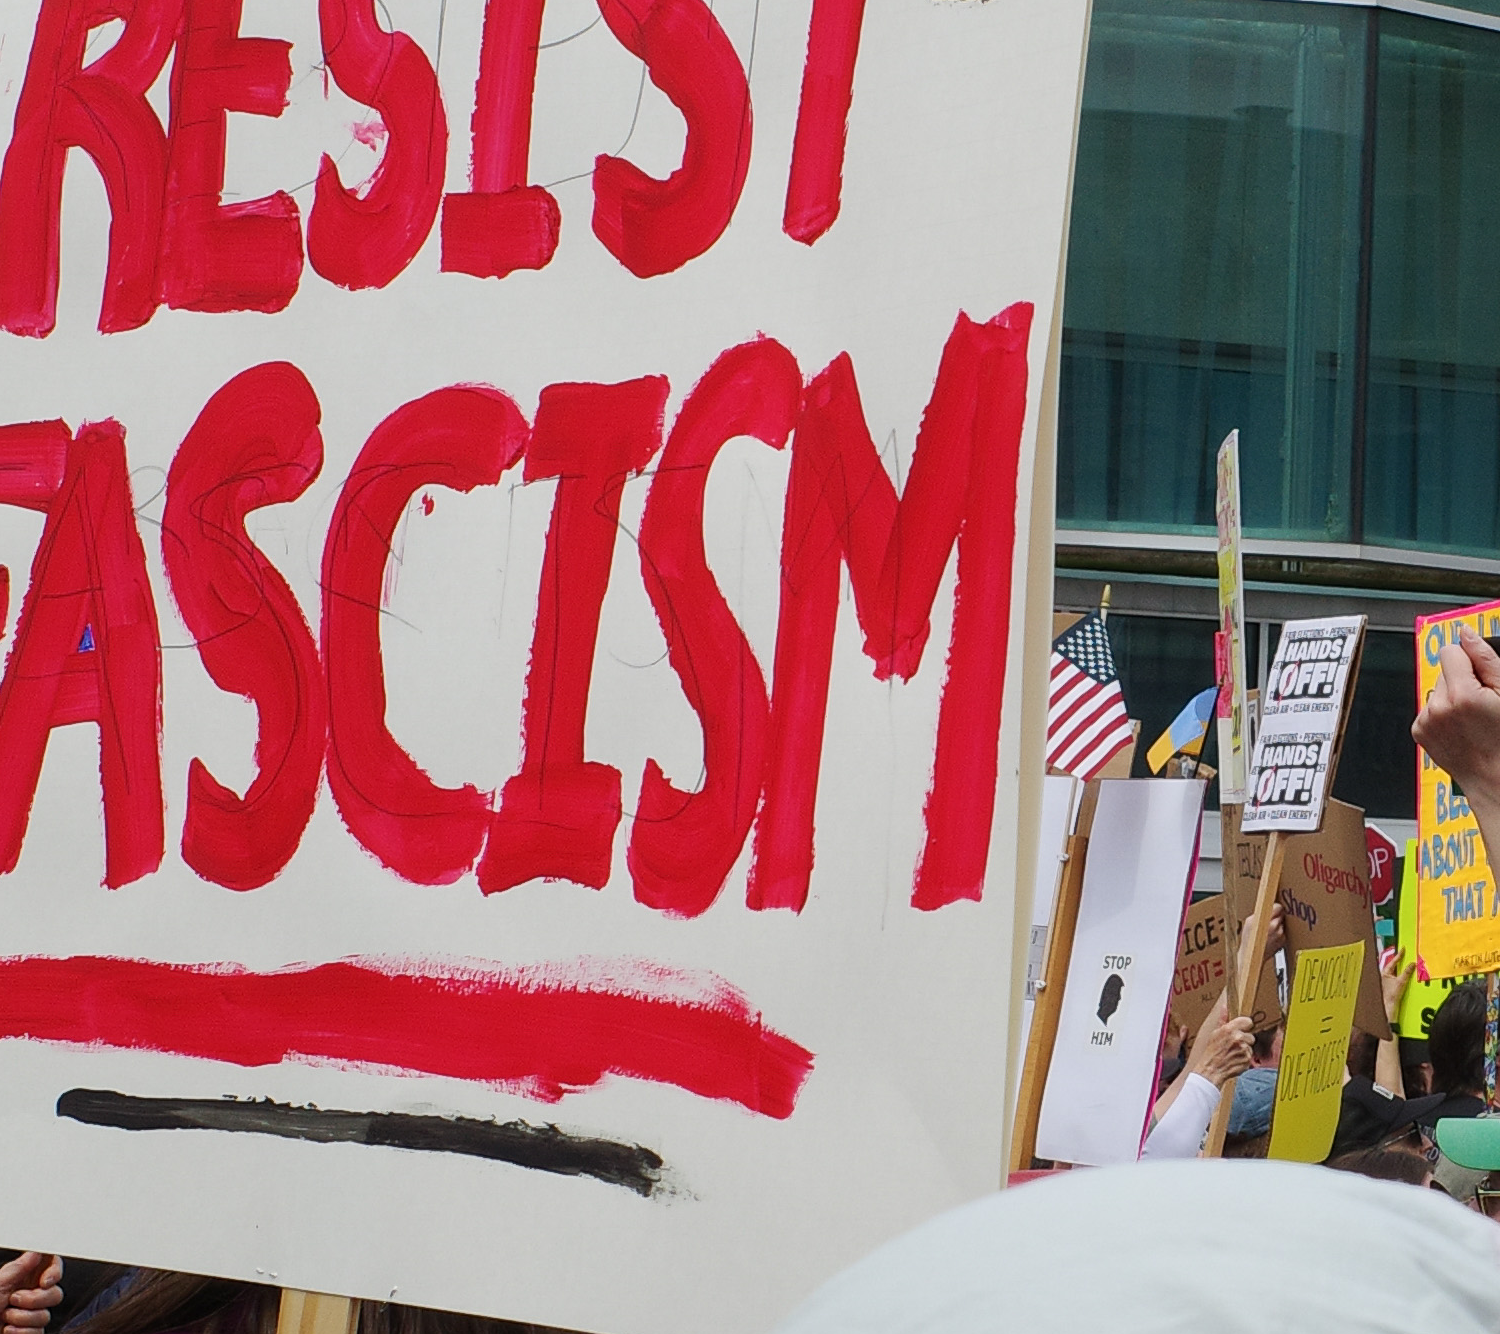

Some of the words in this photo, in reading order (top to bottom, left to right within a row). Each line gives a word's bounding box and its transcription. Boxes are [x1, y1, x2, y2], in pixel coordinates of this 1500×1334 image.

[1284, 638, 1343, 663] HANDS
[1276, 662, 1339, 699] OFF!
[1262, 743, 1320, 768] HANDS
[1255, 767, 1314, 805] OFF!
[1420, 828, 1479, 881] ABOUT
[1302, 852, 1370, 909] Oligarchy
[1442, 880, 1487, 925] THAT
[1183, 915, 1219, 956] ICE
[1102, 955, 1132, 970] STOP
[1090, 1031, 1114, 1046] HIM
